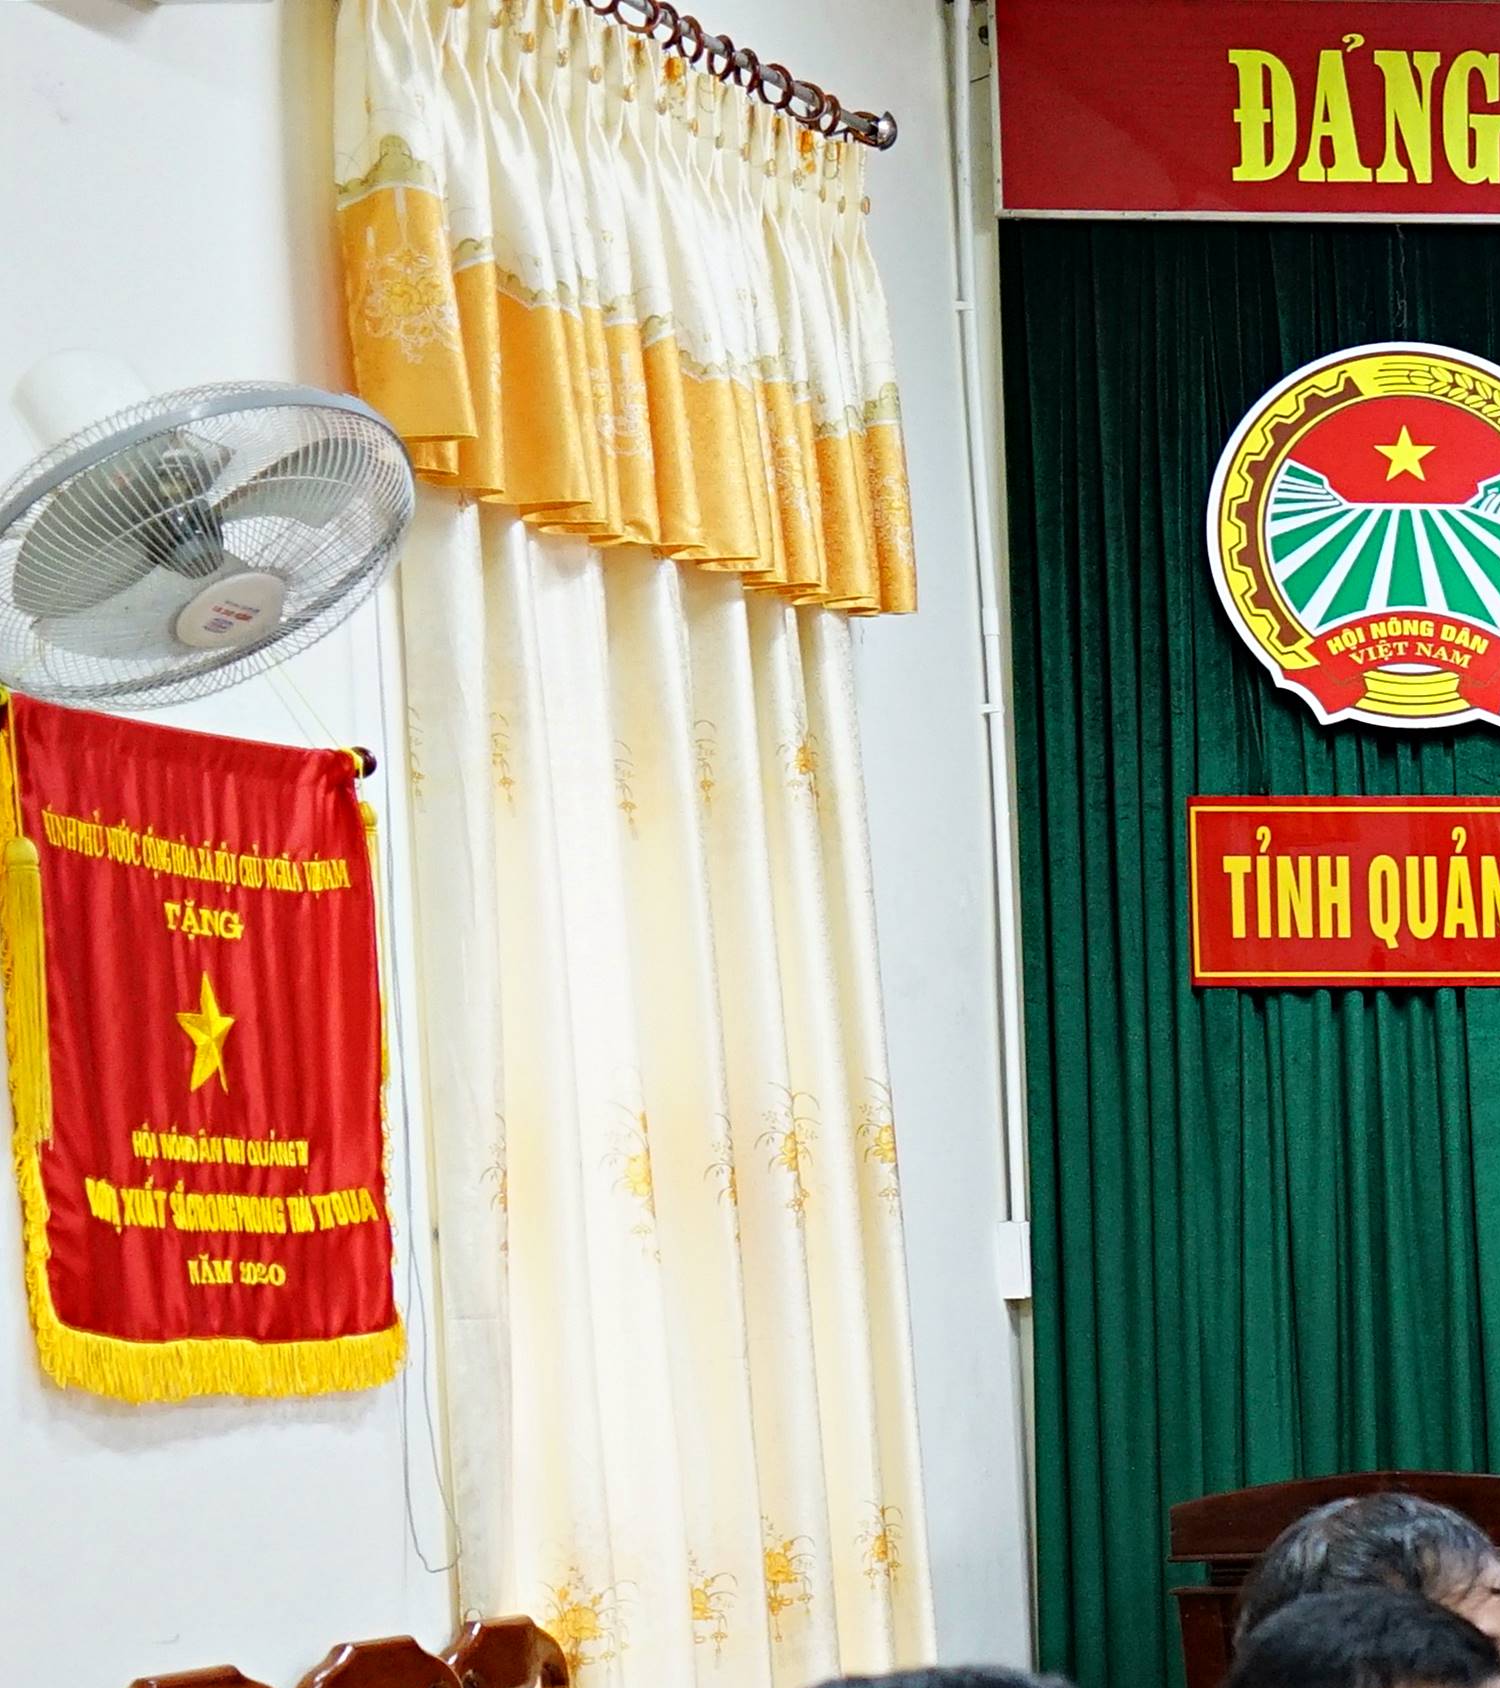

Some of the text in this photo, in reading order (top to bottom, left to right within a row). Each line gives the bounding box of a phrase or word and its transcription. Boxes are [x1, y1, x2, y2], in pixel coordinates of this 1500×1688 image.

[1326, 616, 1489, 656] HỘI NÔNG DÂN
[1348, 639, 1473, 669] VIỆT NAM
[1222, 825, 1354, 940] TỈNH
[164, 897, 245, 942] TẶNG
